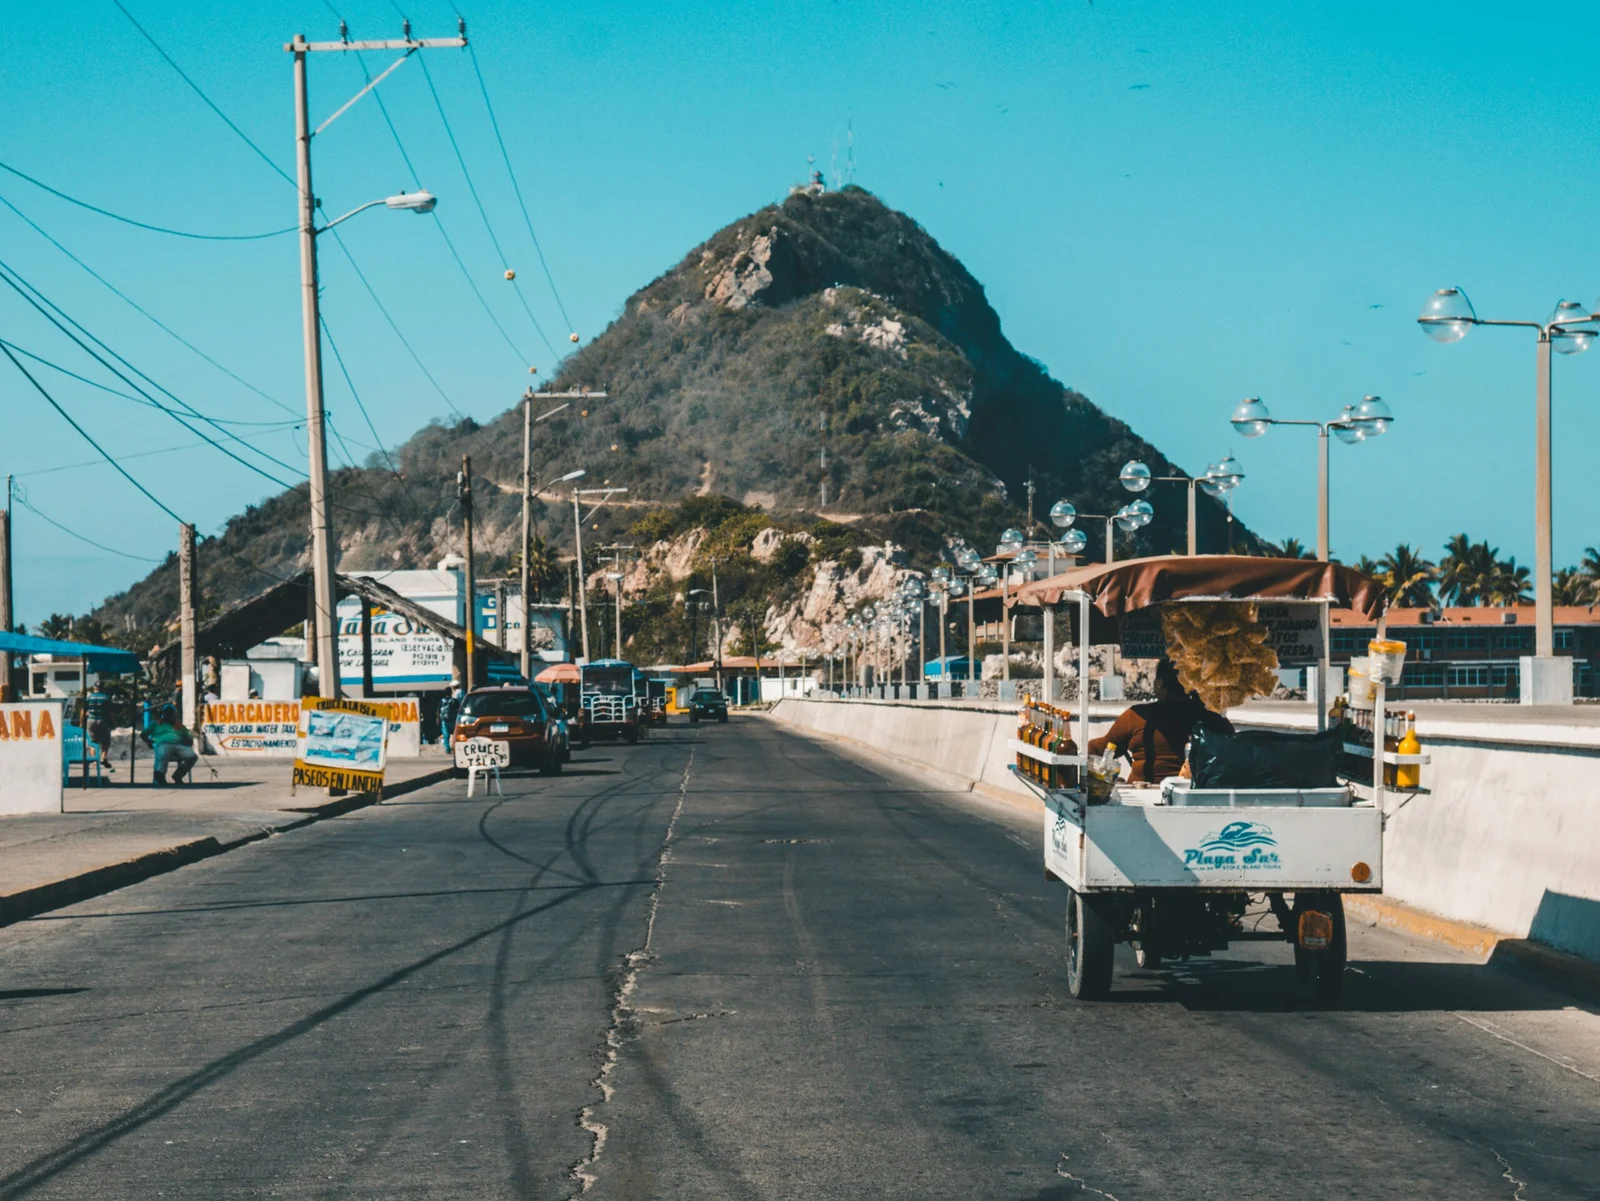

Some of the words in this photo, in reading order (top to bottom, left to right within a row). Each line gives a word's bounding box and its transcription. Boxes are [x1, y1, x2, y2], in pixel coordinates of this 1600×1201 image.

[228, 725, 253, 734] ISLAND
[256, 725, 278, 734] WATER
[464, 744, 499, 756] CRUCE
[293, 768, 329, 787] PASEOS
[329, 772, 344, 791] EN
[345, 774, 384, 794] LANCHA
[1184, 849, 1235, 868] Playa
[1243, 848, 1279, 864] Sur
